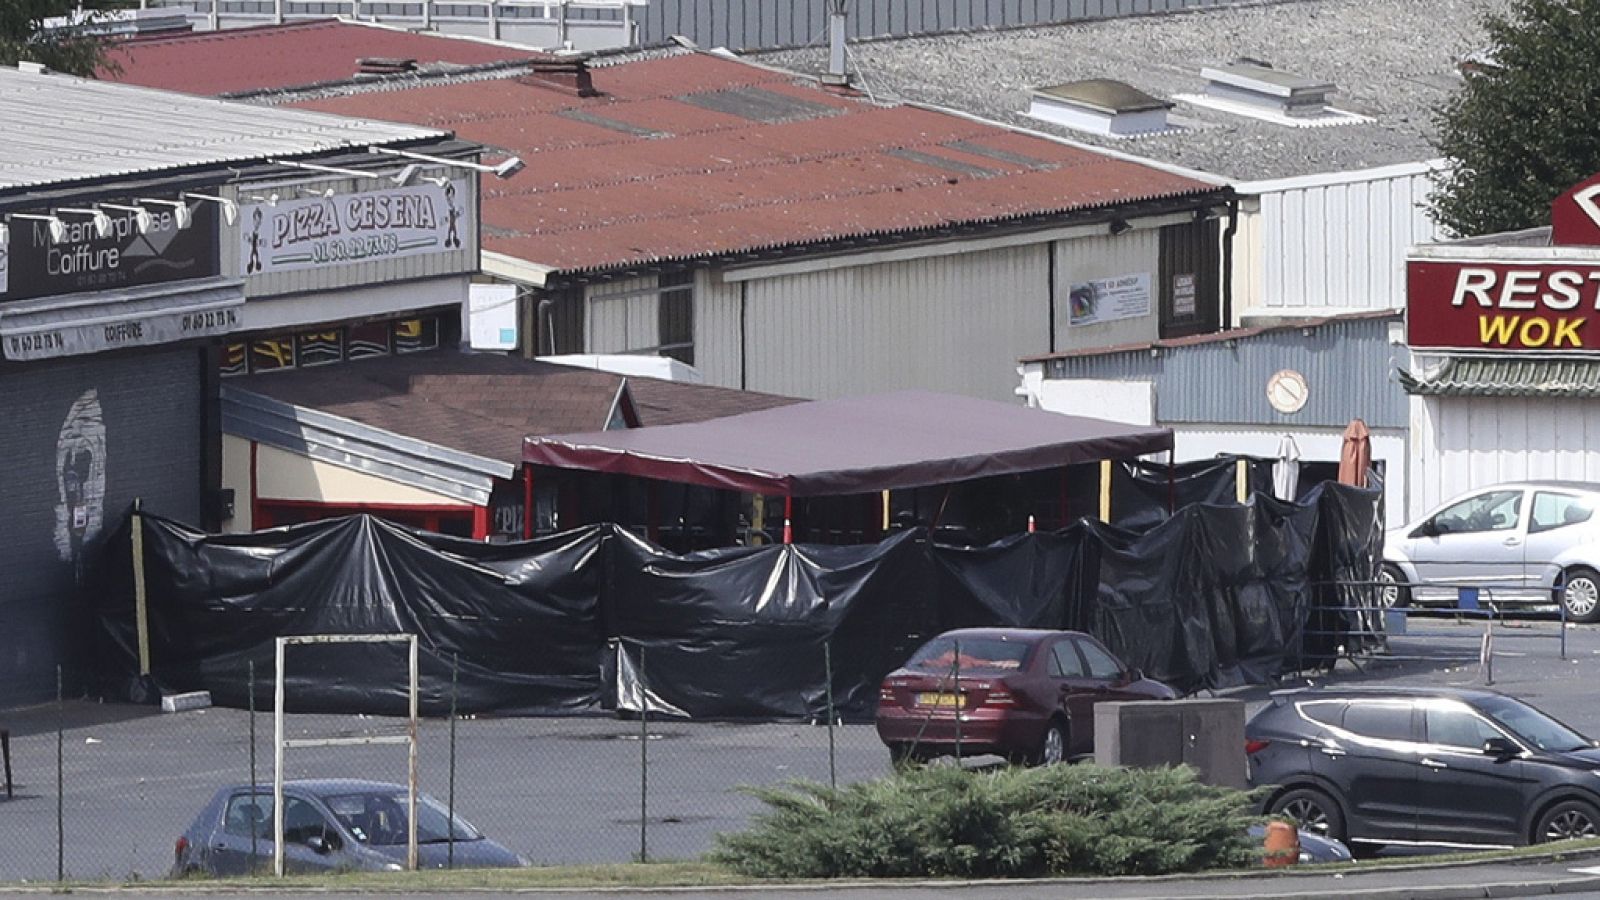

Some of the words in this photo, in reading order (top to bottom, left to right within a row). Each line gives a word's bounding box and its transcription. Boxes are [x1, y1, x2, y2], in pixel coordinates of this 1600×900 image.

[33, 210, 171, 248] Mtamrphse
[272, 197, 341, 249] PIZZA
[345, 195, 437, 232] CESENA
[47, 244, 120, 276] Coiffure
[104, 322, 143, 342] COIFFURE
[1478, 315, 1587, 348] WOK
